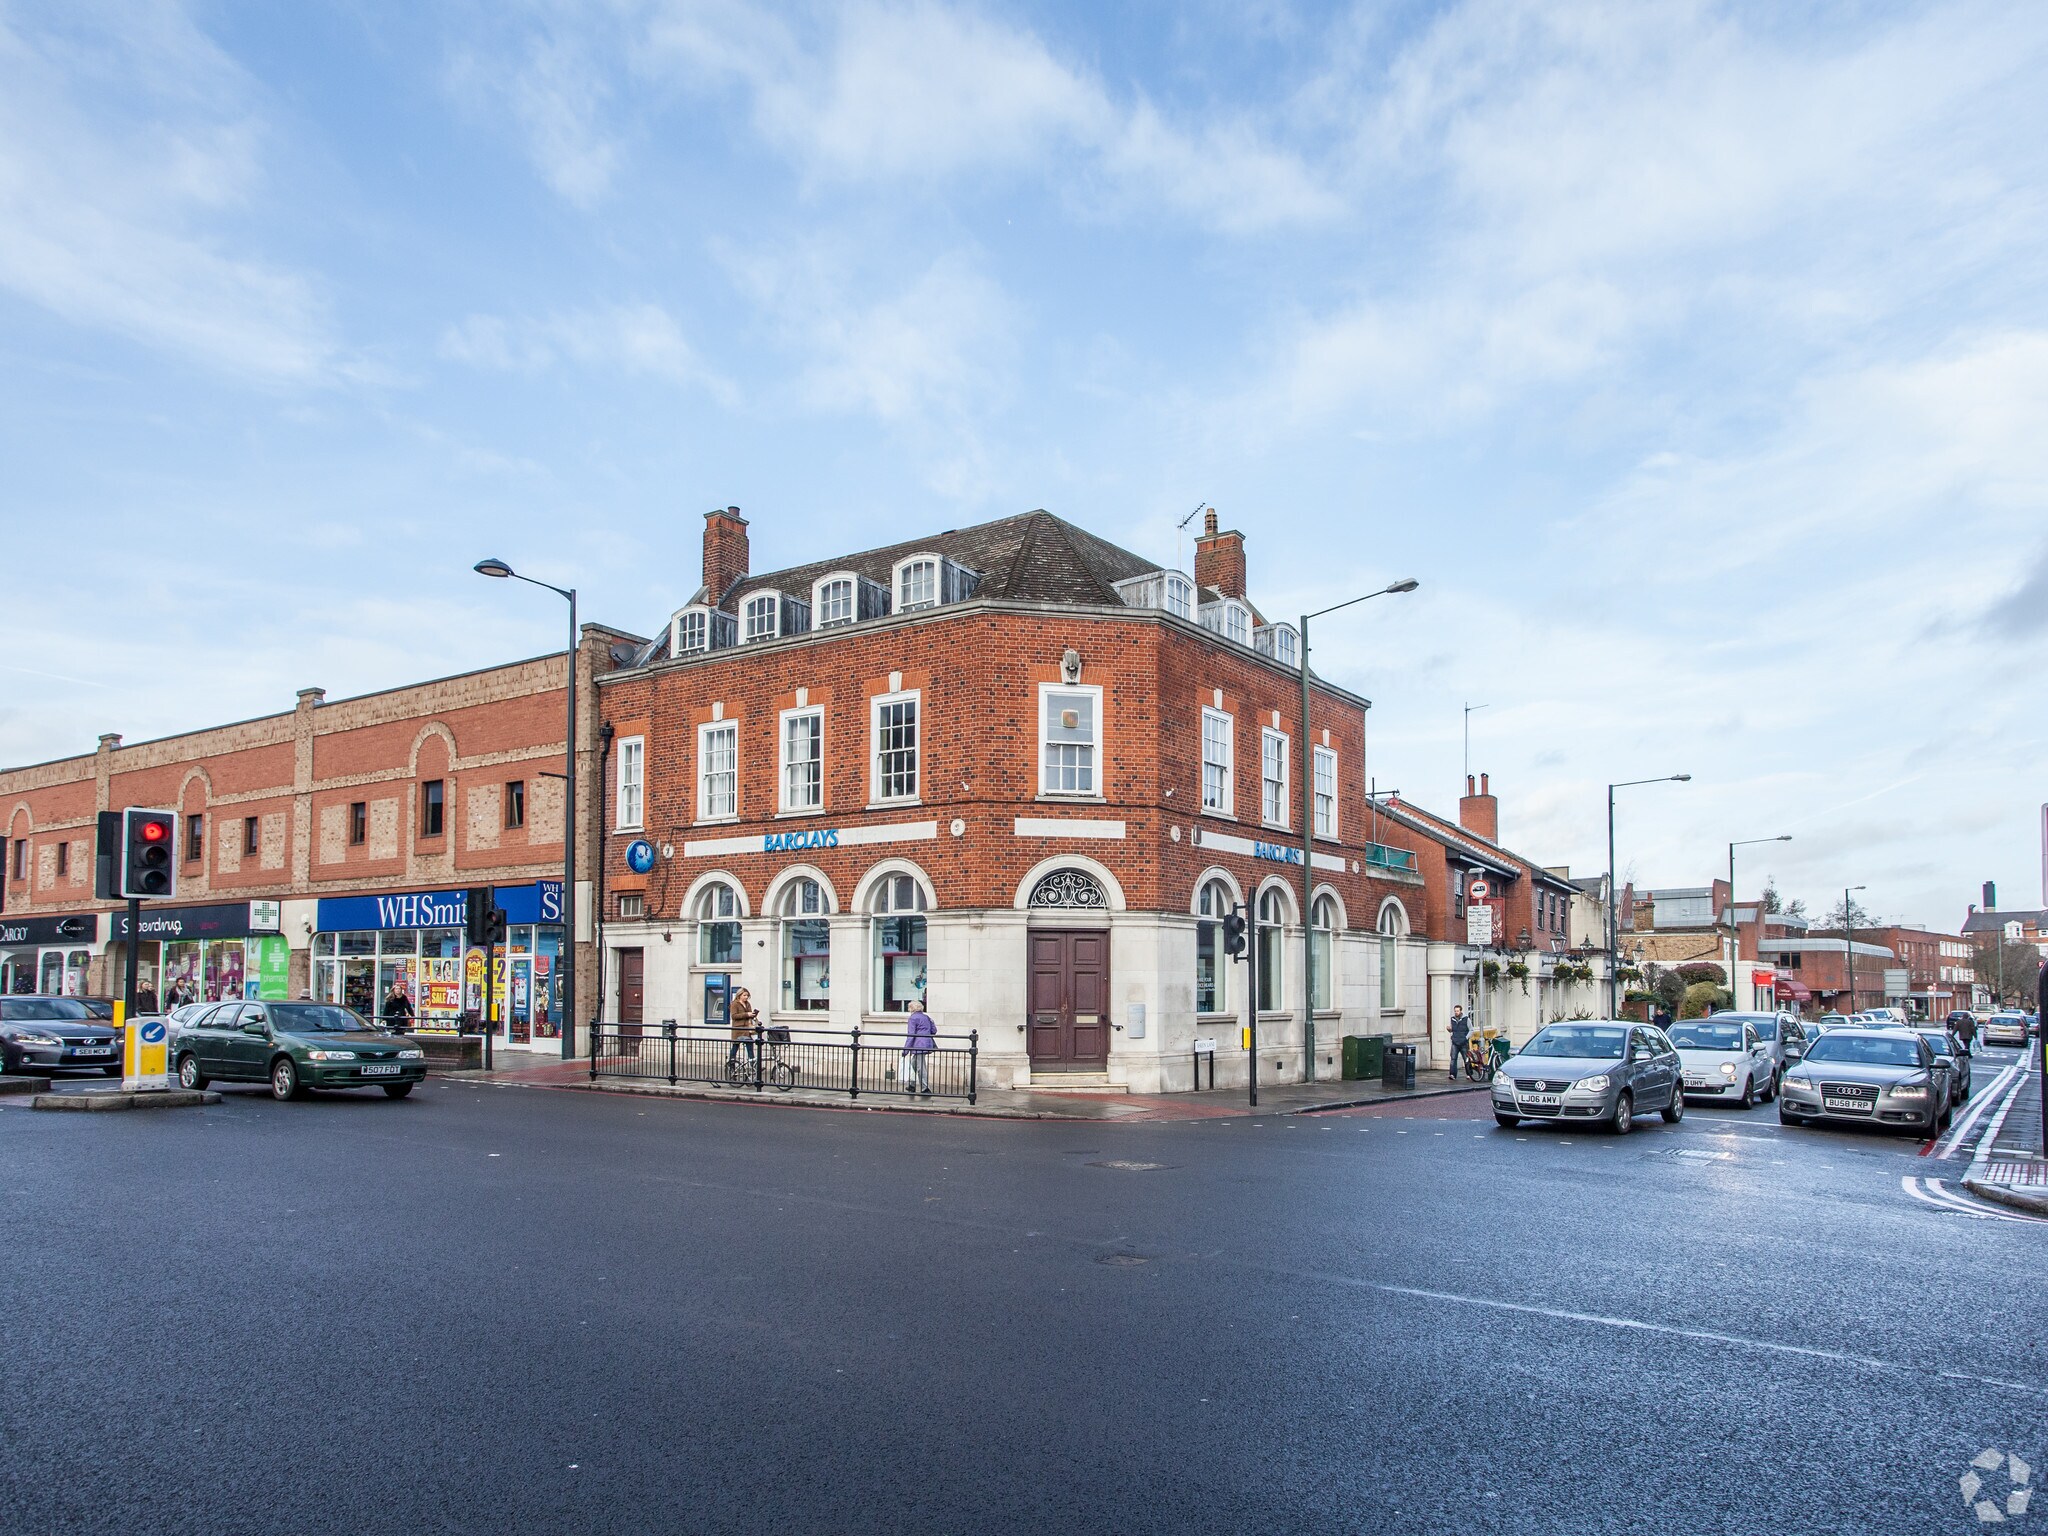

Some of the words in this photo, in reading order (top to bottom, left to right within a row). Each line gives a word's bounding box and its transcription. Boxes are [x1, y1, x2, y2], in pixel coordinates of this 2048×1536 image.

[764, 828, 839, 852] BARCLAYS
[1253, 840, 1300, 865] BARCLAYS
[543, 883, 559, 892] WH
[377, 893, 468, 928] WHSmit
[542, 891, 559, 920] S
[121, 917, 183, 935] Serdrug
[432, 992, 446, 1004] SALE
[1521, 1095, 1540, 1103] LJ06
[1829, 1099, 1850, 1107] BU58
[1851, 1101, 1869, 1109] FRP
